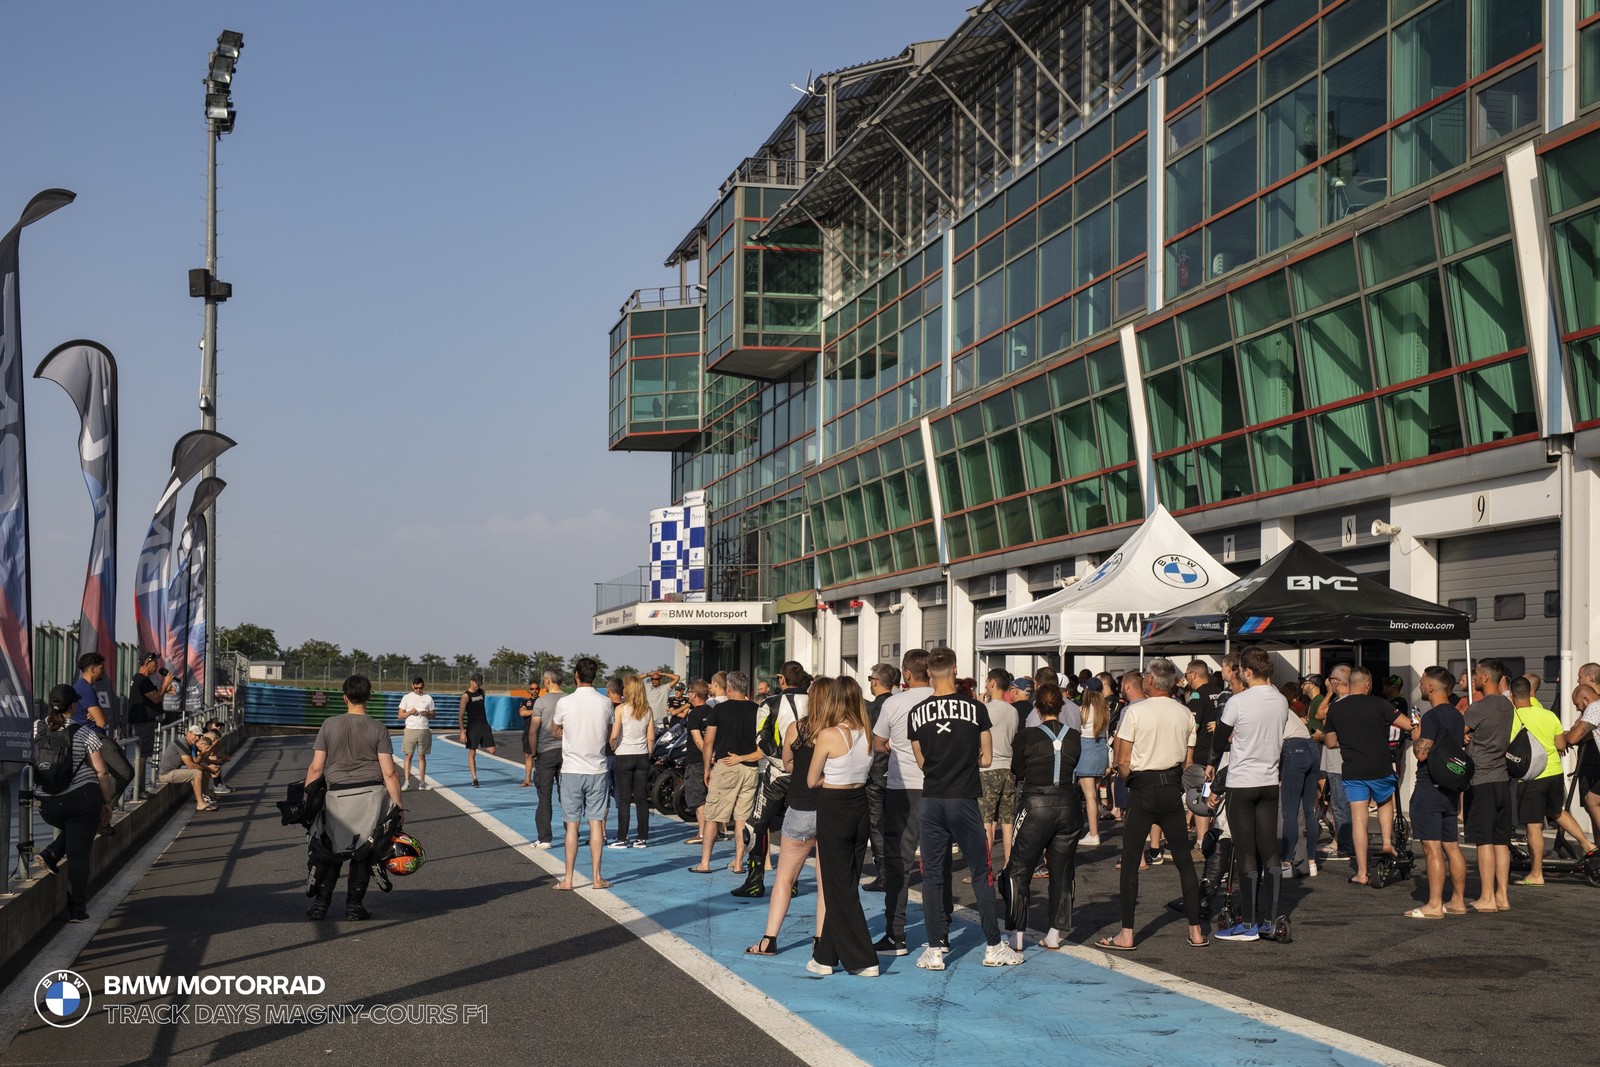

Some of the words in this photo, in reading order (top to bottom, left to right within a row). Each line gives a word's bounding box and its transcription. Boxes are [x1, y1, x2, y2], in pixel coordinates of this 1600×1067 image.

[1476, 495, 1486, 522] 9
[1345, 518, 1353, 543] 8
[1226, 537, 1232, 559] 7
[1157, 556, 1196, 568] BMW
[1286, 575, 1358, 591] BMC
[669, 609, 694, 618] BMW
[696, 609, 748, 619] Motorsport
[984, 619, 1003, 640] BMW
[1004, 614, 1051, 638] MOTORRAD
[1389, 620, 1455, 631] bmc-moto.com
